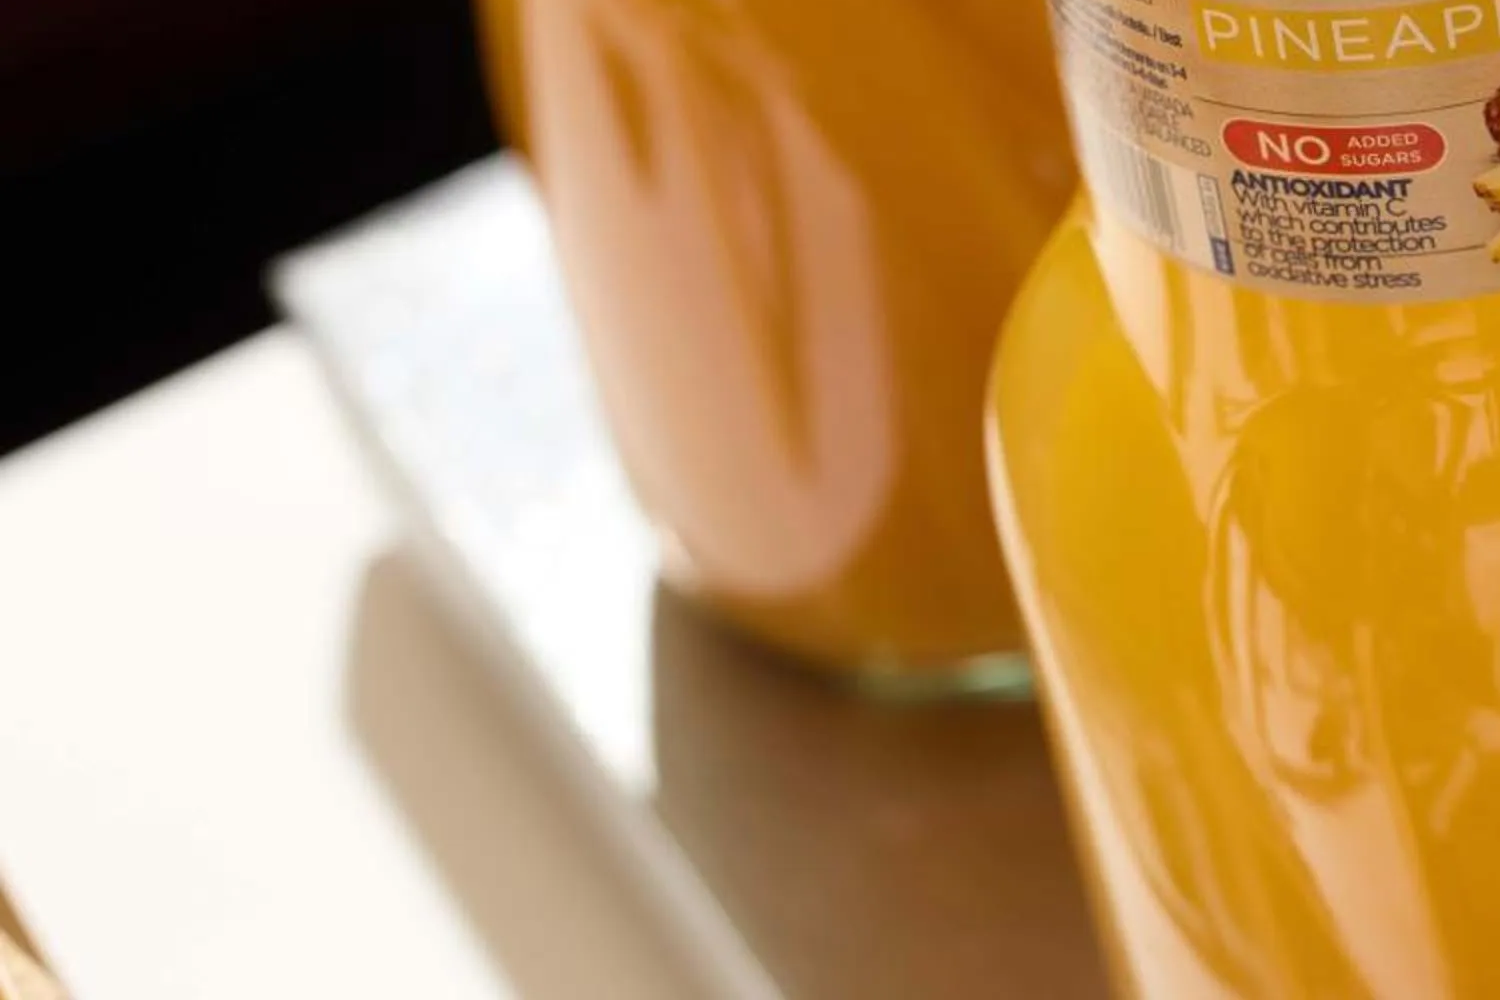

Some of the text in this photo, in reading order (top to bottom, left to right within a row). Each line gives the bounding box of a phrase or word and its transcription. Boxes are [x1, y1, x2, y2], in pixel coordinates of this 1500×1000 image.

[1257, 130, 1418, 166] NO ADDED
[1340, 150, 1422, 168] SUGARS
[1231, 169, 1413, 198] ANTIOXIDANT
[1233, 184, 1407, 218] With vitamin C
[1238, 206, 1447, 236] which contributes
[1241, 223, 1436, 258] to the protection
[1244, 240, 1383, 271] of cells from
[1247, 260, 1422, 289] oxidative stress
